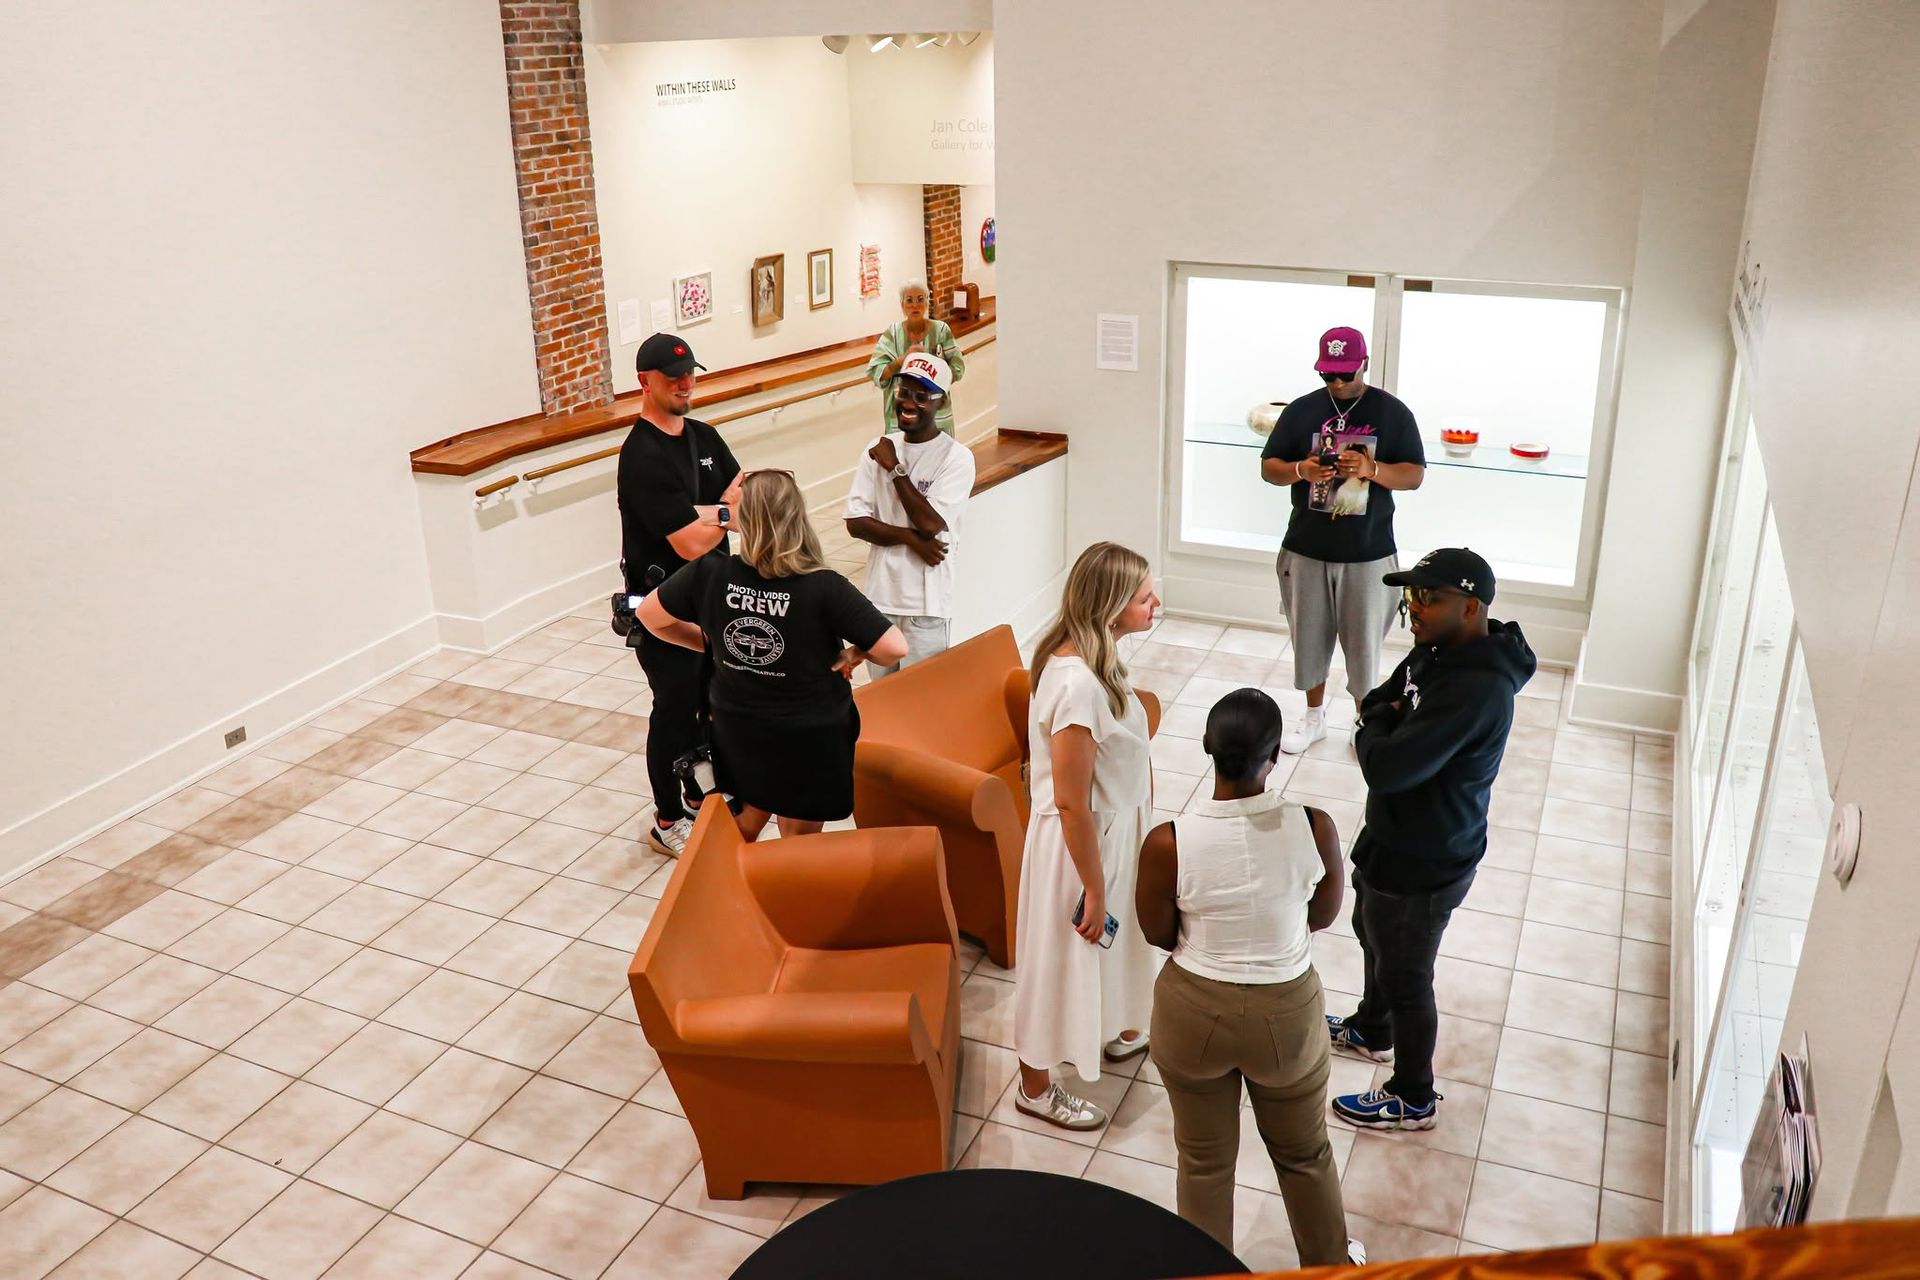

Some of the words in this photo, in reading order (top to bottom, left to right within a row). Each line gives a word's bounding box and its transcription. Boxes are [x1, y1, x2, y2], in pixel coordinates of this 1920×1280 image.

[656, 83, 686, 97] WITHIN
[687, 80, 711, 94] THESE
[711, 78, 737, 92] WALLS
[930, 119, 954, 133] Jan
[931, 139, 966, 152] Gallery
[969, 139, 984, 151] for
[727, 583, 757, 597] PHOTO
[762, 591, 791, 601] VIDEO
[725, 592, 791, 617] CREW
